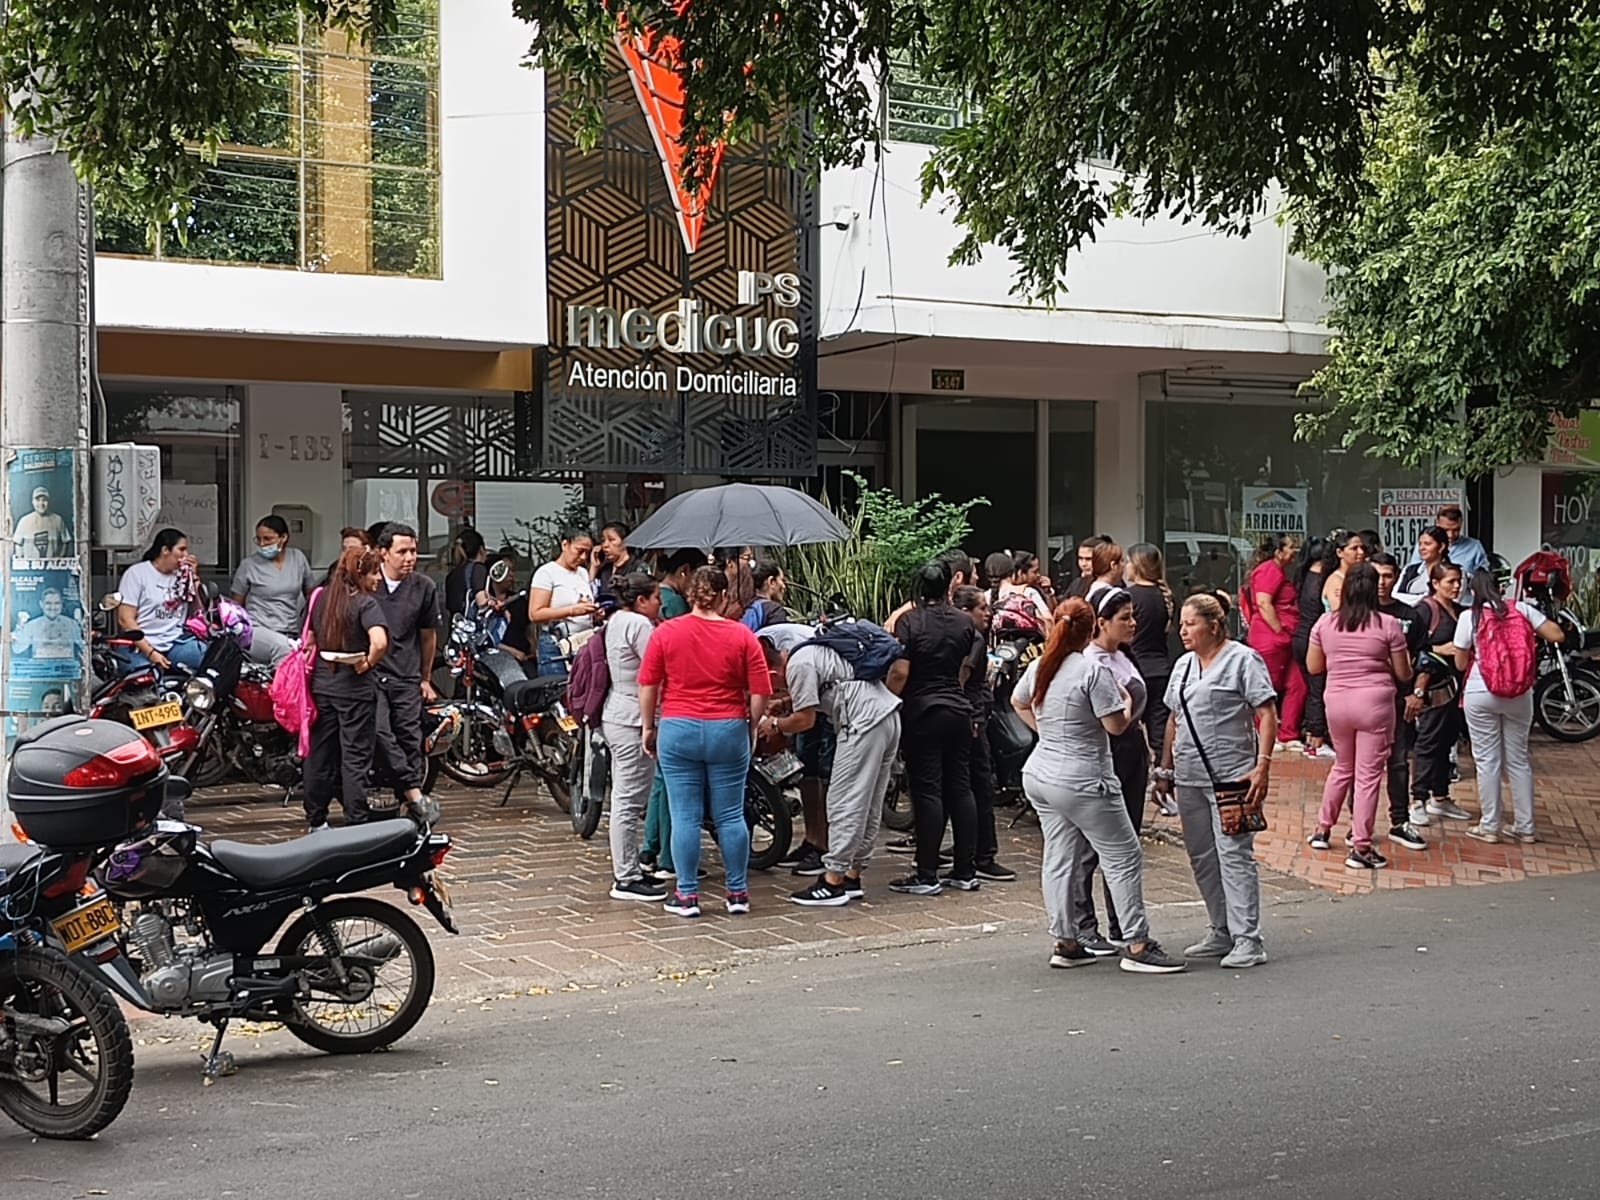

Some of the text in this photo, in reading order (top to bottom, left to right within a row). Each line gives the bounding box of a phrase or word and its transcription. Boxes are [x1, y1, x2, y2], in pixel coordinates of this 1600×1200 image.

[738, 270, 800, 307] IPS
[567, 298, 799, 358] medicuc
[568, 361, 797, 396] Atención Domiciliaria
[1396, 490, 1460, 500] RENTAMAS
[1553, 493, 1594, 524] HOY
[1245, 513, 1304, 530] ARRIENDA
[1384, 518, 1405, 547] 315
